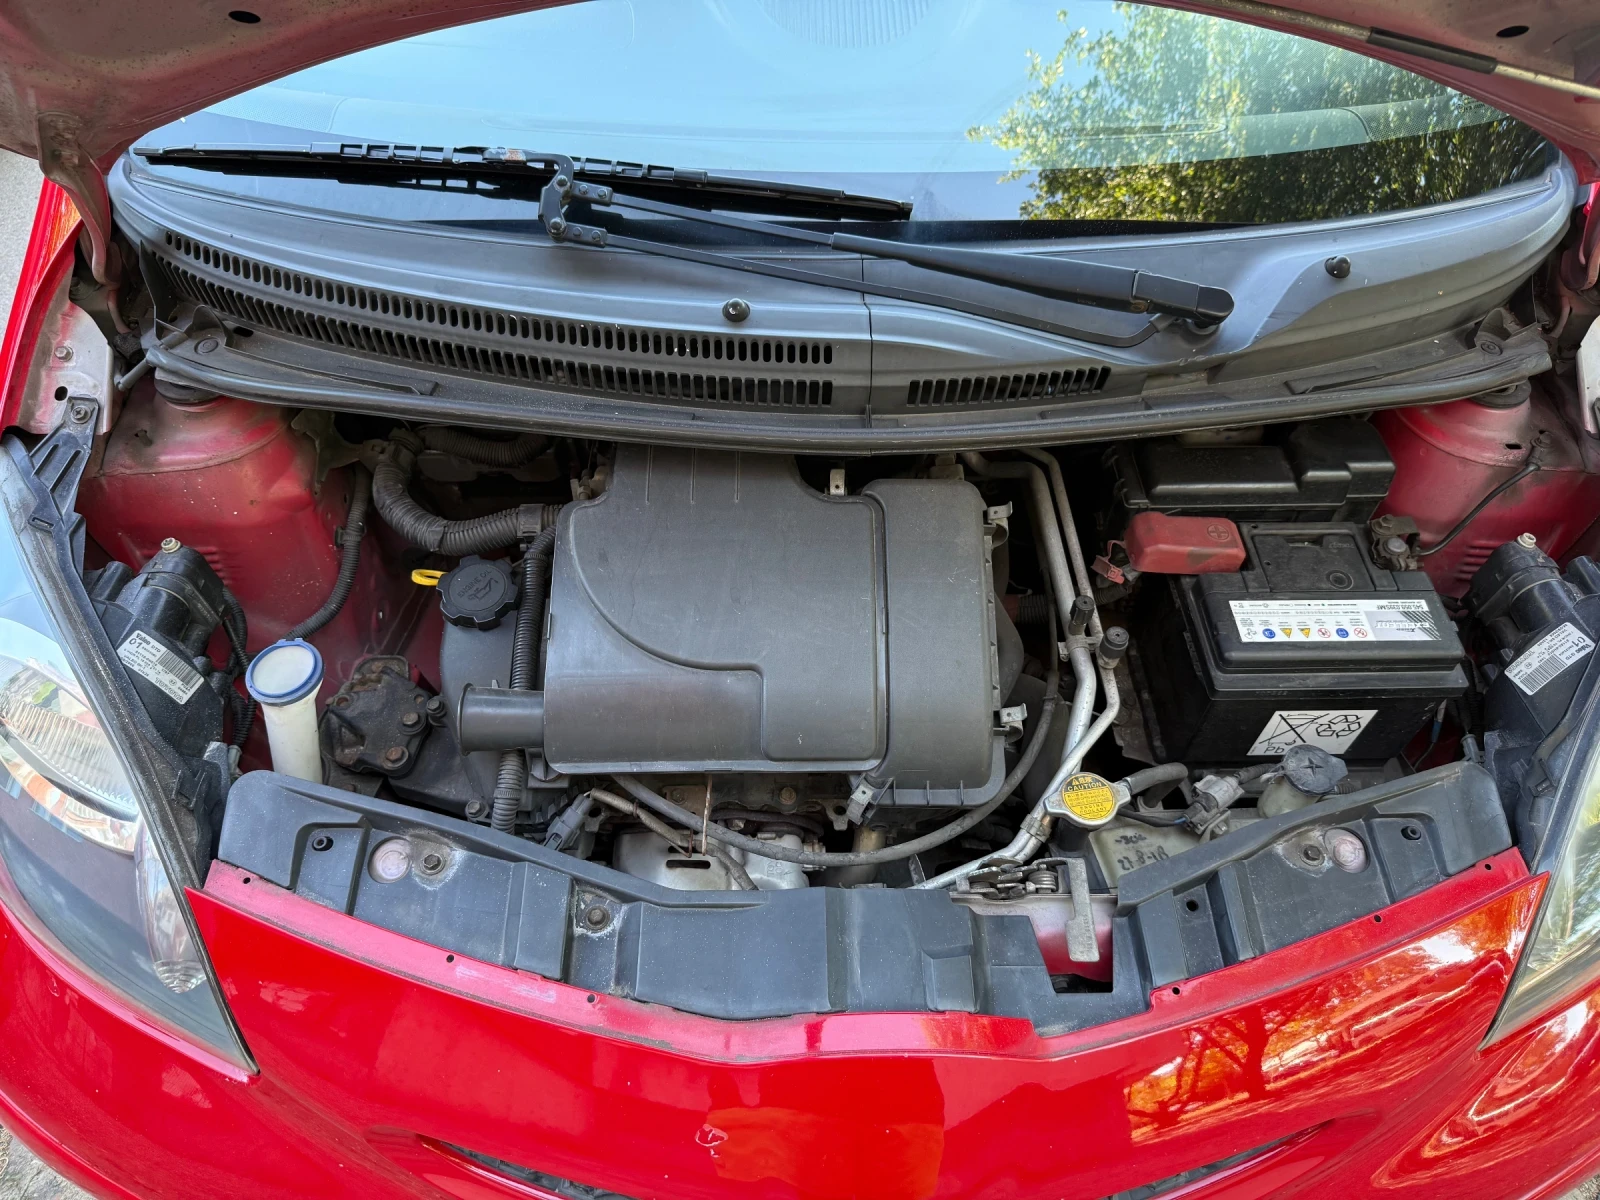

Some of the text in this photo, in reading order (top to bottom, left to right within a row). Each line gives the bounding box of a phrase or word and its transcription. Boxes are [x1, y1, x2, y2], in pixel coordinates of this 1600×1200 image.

[456, 570, 492, 598] ENGINE OIL
[128, 637, 143, 649] 01
[136, 633, 152, 646] Valeo
[1572, 636, 1586, 647] 01
[1264, 746, 1285, 754] Pb
[1067, 782, 1102, 792] CAUTION
